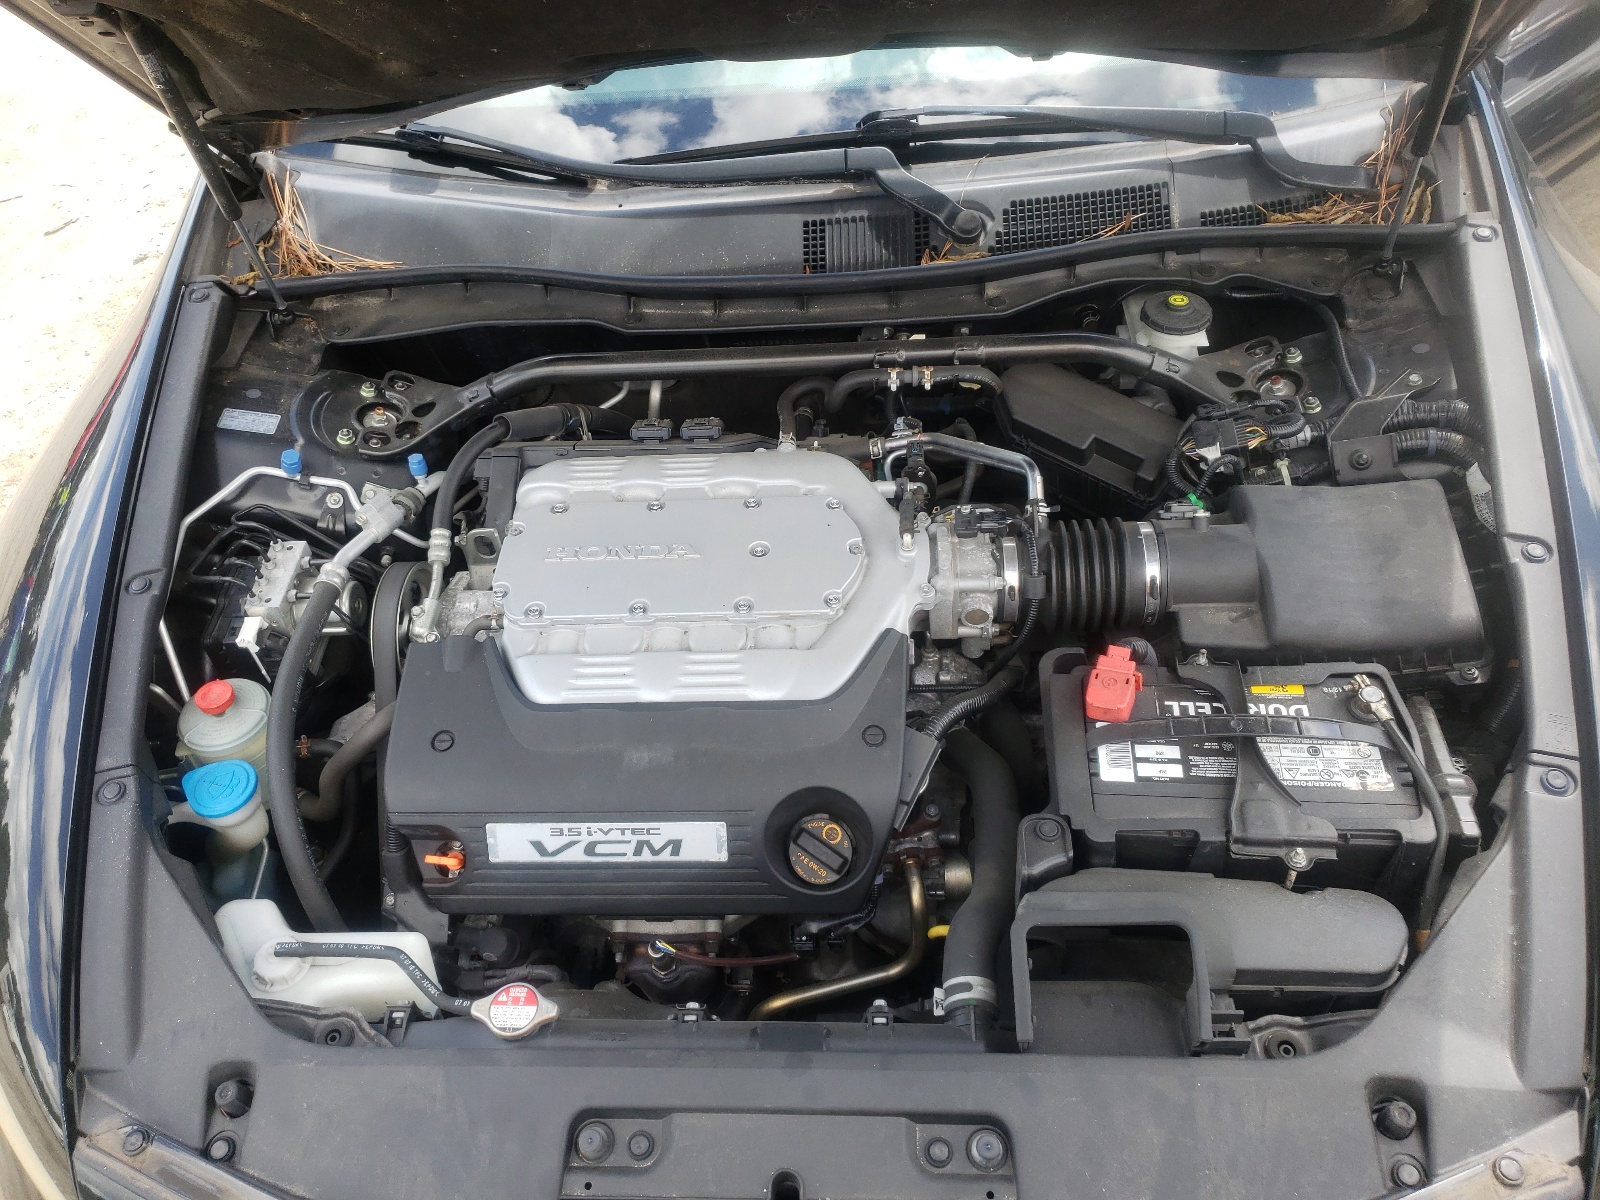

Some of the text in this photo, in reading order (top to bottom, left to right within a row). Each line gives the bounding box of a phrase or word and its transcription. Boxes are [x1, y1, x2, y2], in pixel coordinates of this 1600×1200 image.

[544, 543, 701, 562] HONDA
[550, 826, 662, 837] 3.5 i-VTEC
[527, 838, 684, 858] VCM
[808, 861, 827, 877] 0W-20
